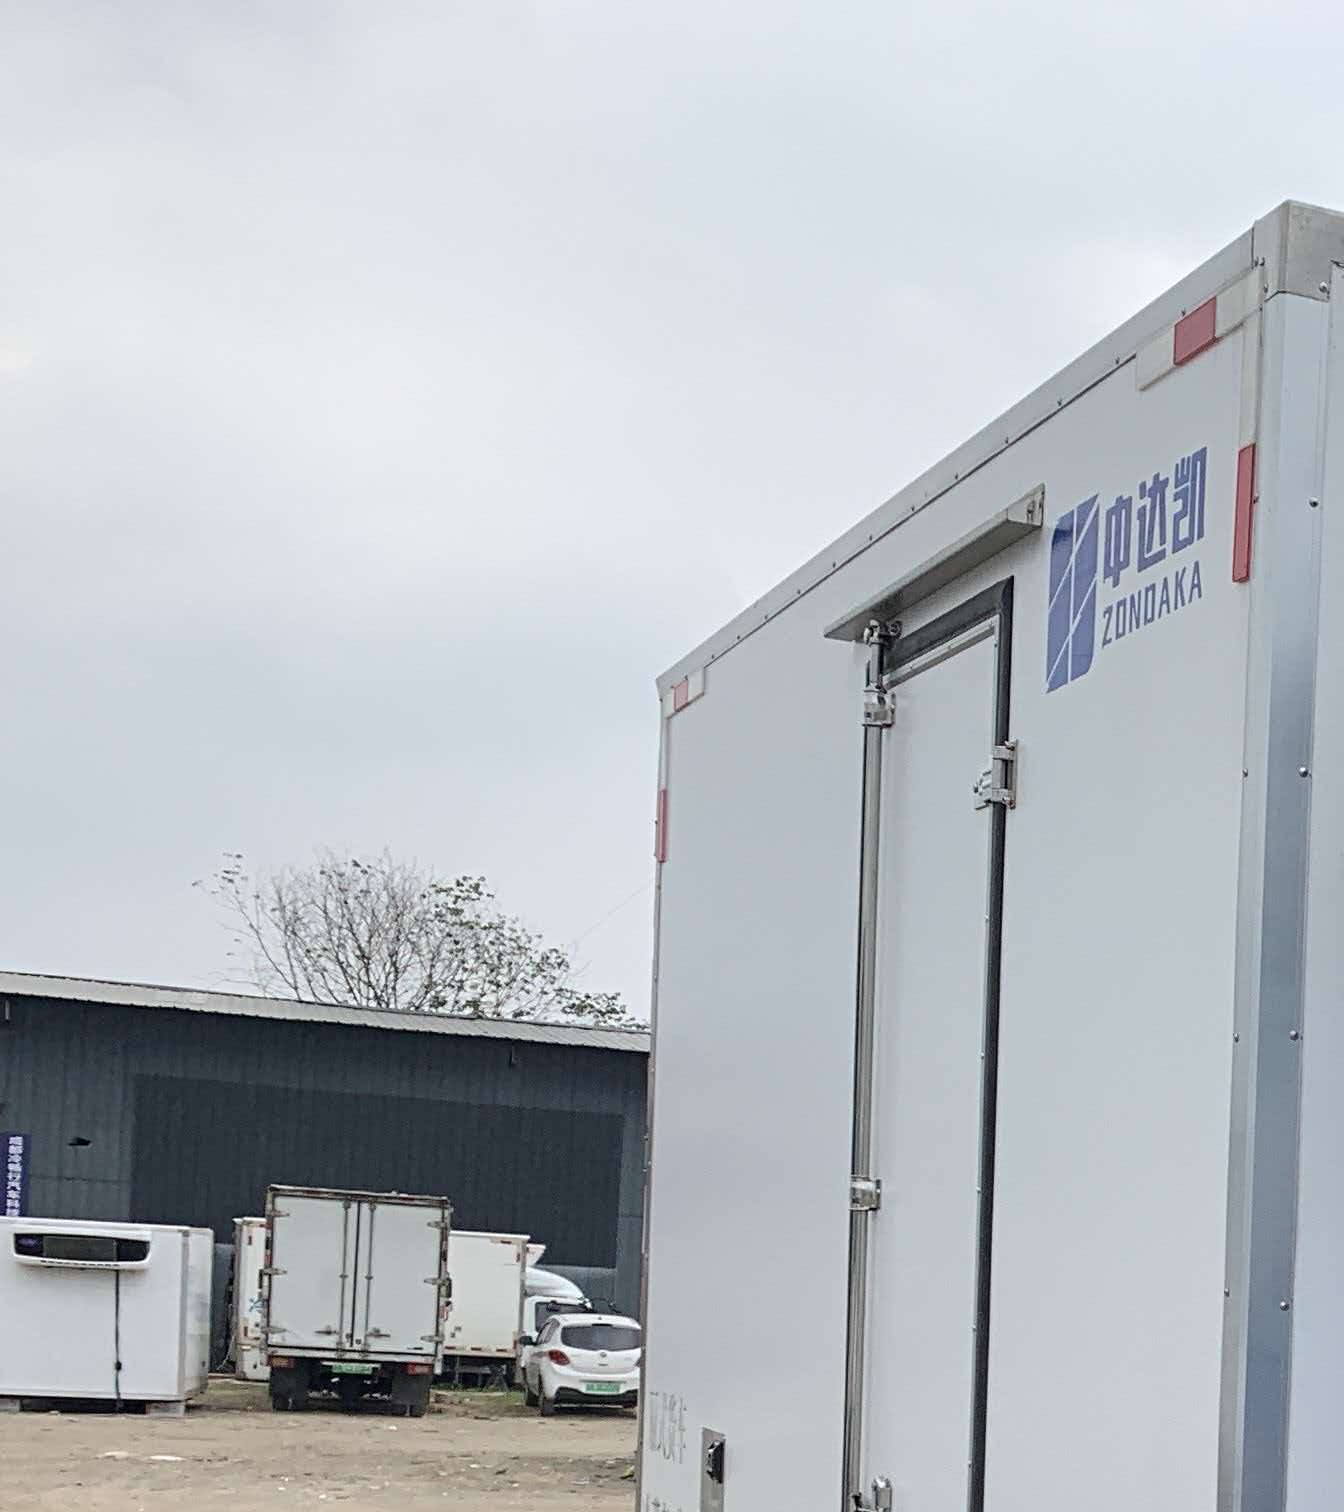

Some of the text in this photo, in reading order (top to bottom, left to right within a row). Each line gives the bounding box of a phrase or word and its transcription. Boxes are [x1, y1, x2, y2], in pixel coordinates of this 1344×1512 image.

[1102, 445, 1208, 589] 中达凯
[1101, 560, 1203, 650] ZONDAKA
